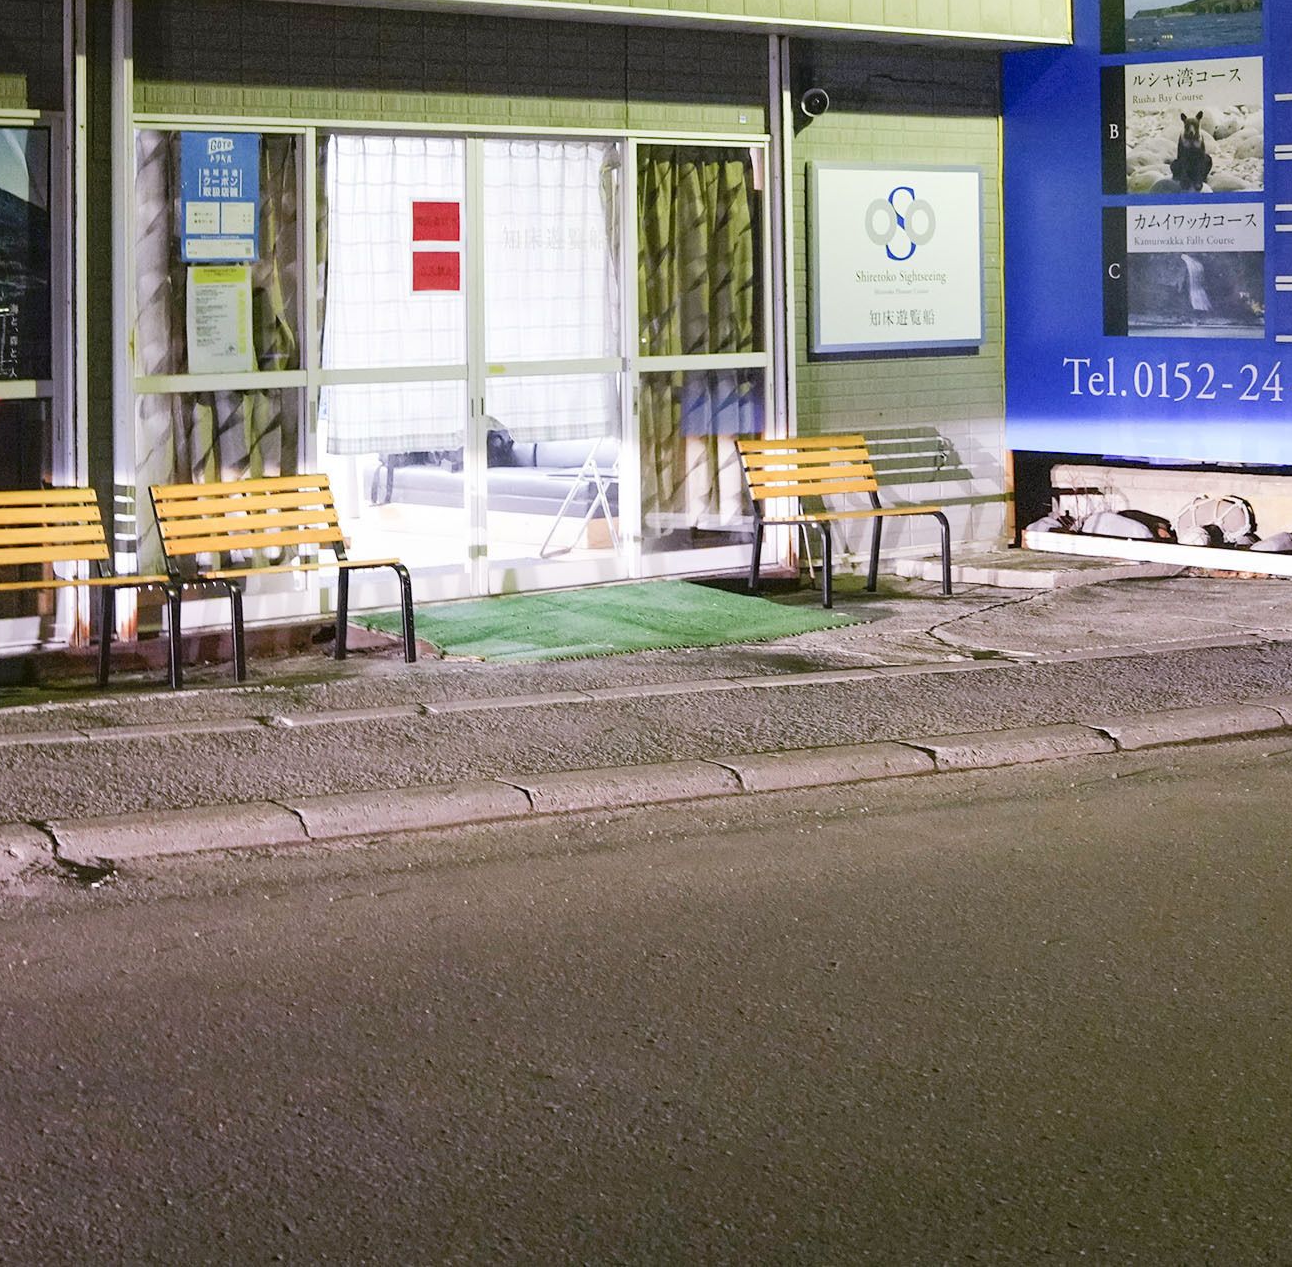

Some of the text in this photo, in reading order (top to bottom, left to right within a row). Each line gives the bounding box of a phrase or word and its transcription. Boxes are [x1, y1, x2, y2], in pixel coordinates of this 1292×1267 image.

[1133, 67, 1241, 88] ルシャ湾コース
[1132, 91, 1204, 105] Rusha Bay Course
[1109, 123, 1119, 139] B
[1134, 213, 1257, 230] カムイワッカコース
[1186, 235, 1204, 246] Falls
[1206, 235, 1236, 246] Course
[855, 268, 947, 285] Shiretoko Sightseeing
[1108, 263, 1121, 279] C
[869, 308, 936, 327] 知床遊覧船
